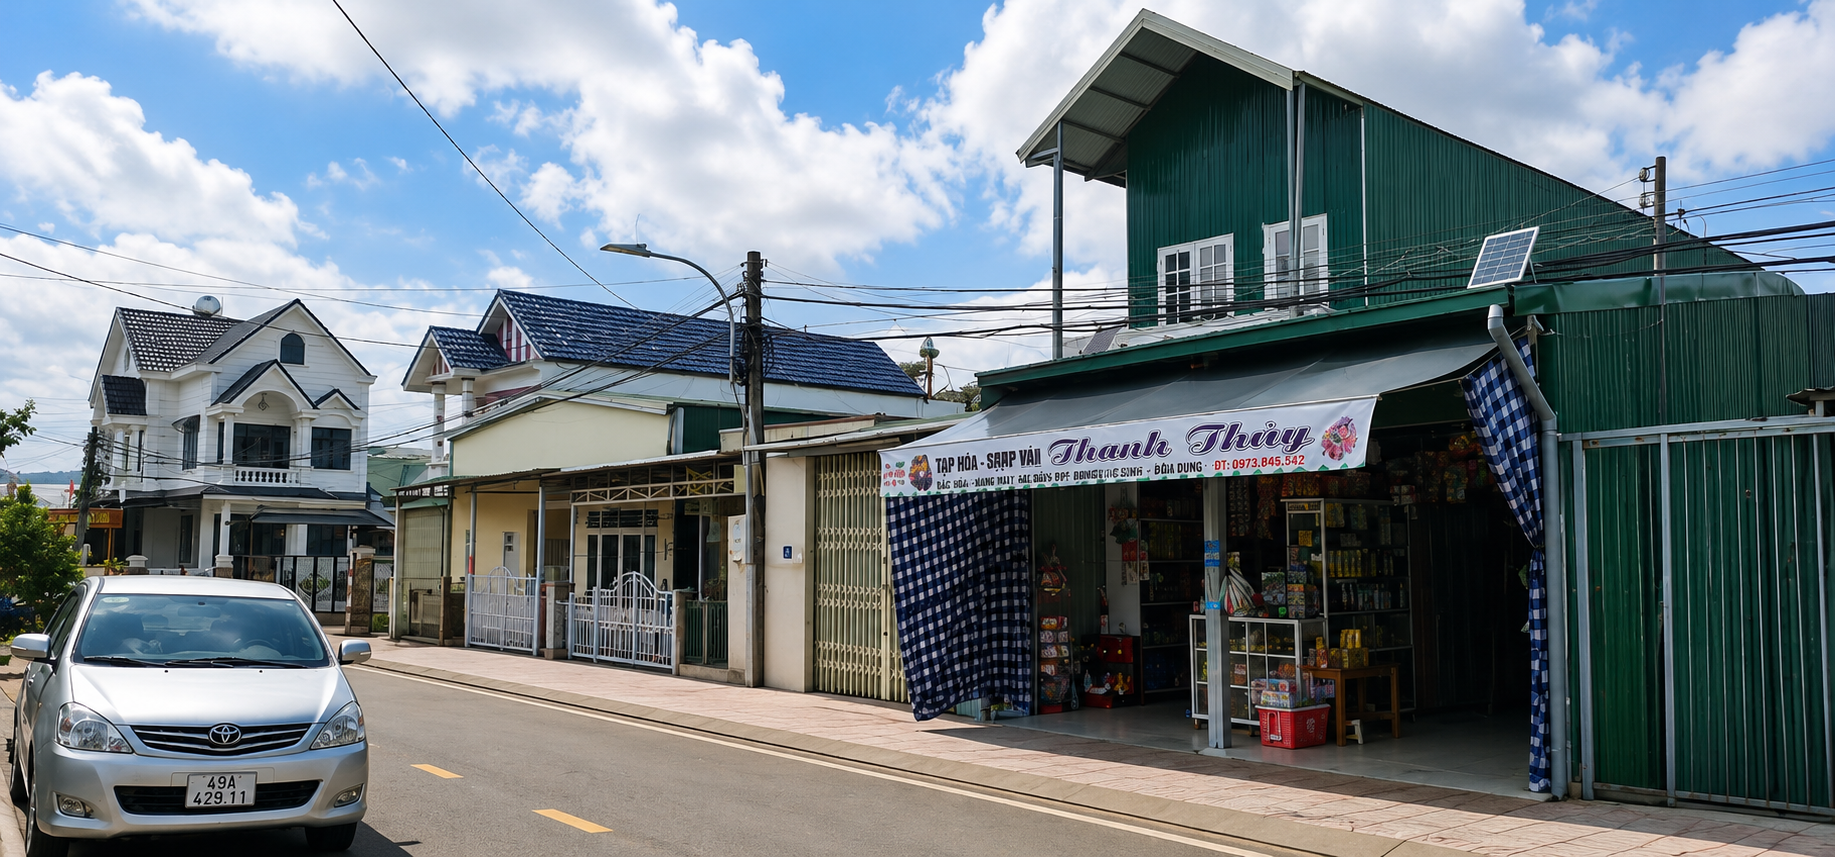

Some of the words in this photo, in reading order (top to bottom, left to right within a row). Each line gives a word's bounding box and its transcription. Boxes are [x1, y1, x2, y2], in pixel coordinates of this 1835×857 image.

[1048, 429, 1173, 465] Thanh
[1186, 420, 1315, 455] Thủy
[935, 457, 955, 477] TẠP
[957, 452, 978, 472] HÓA
[1177, 461, 1203, 473] DUNG
[1214, 460, 1230, 471] ĐT:
[1232, 454, 1305, 470] 0973.845.542
[207, 775, 236, 790] 49A
[193, 790, 246, 805] 429.11
